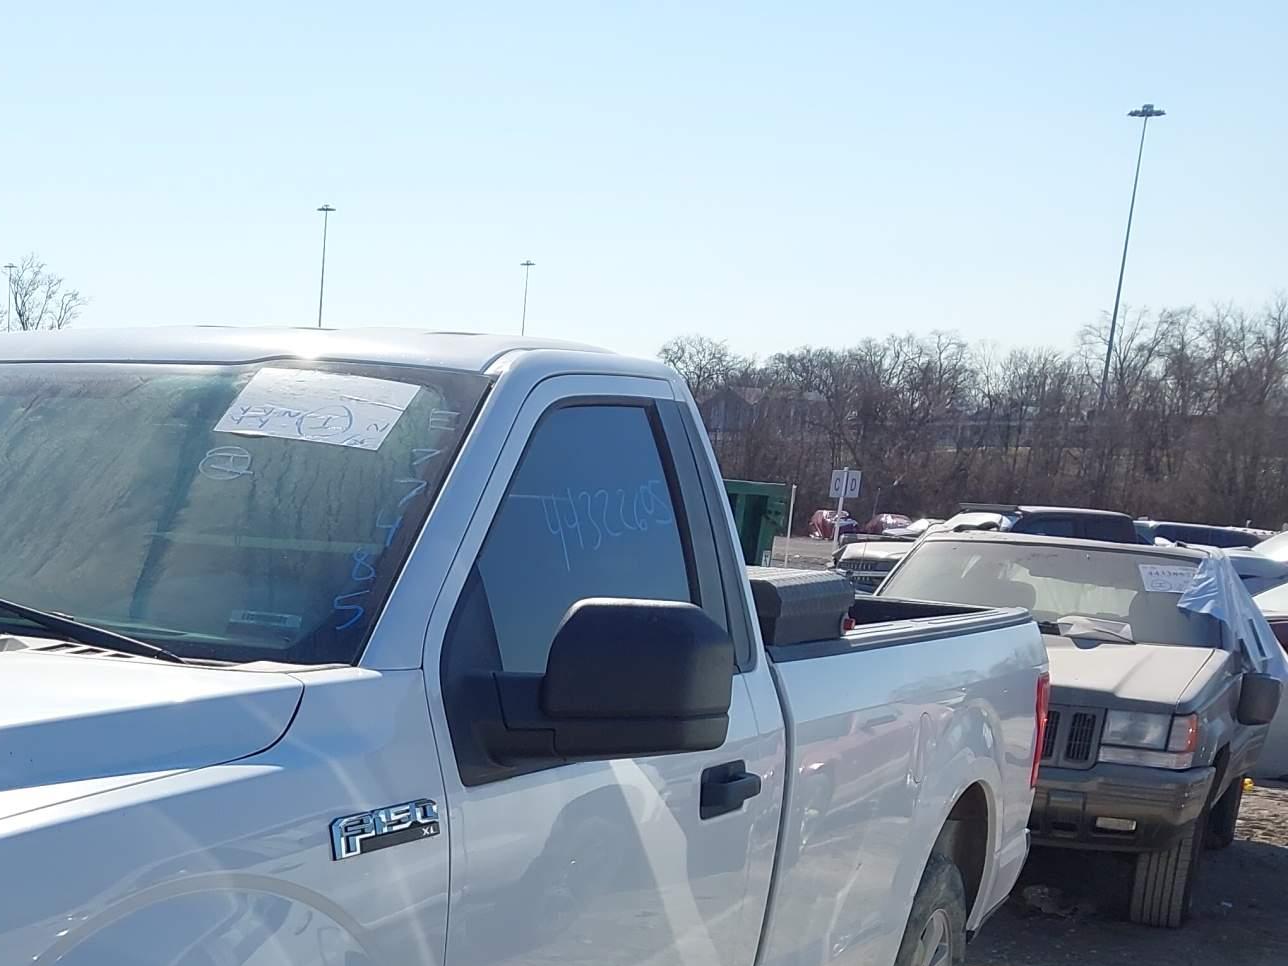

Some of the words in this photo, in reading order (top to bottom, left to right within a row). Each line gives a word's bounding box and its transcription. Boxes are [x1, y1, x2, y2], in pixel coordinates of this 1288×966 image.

[834, 477, 841, 492] C
[850, 478, 857, 492] D
[422, 825, 436, 837] XL
